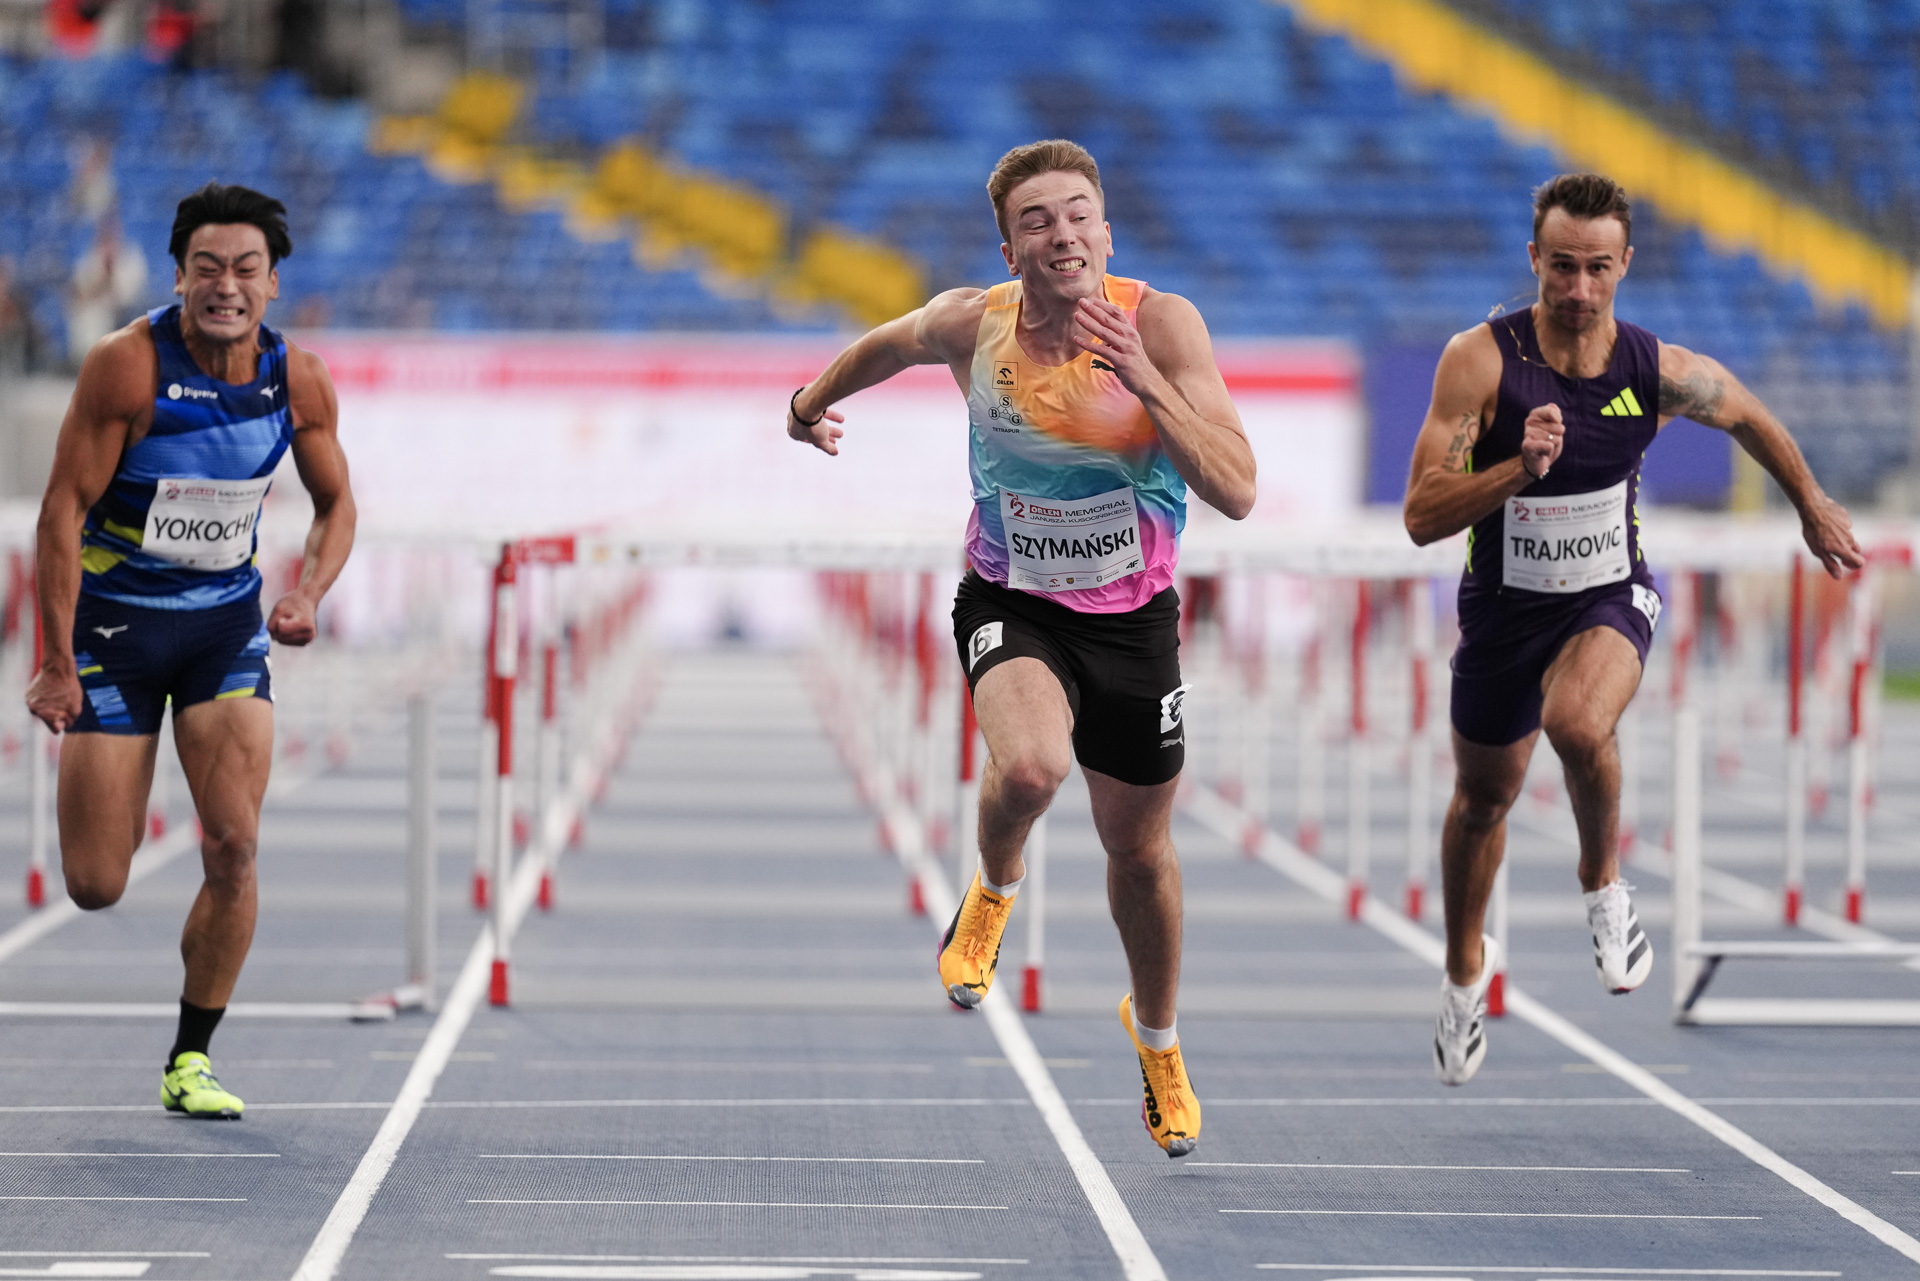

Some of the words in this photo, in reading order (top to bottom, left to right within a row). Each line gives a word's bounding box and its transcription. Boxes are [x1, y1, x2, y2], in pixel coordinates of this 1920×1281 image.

[1002, 397, 1010, 406] S
[991, 409, 998, 418] B
[1011, 414, 1020, 424] G
[1030, 515, 1066, 523] JANUSZA
[1068, 507, 1131, 523] KUSOCIŃSKIEGO
[1031, 506, 1060, 516] ORLEN
[1065, 499, 1129, 517] MEMORIAŁ
[154, 511, 255, 541] YOKOCHI
[1012, 526, 1135, 560] SZYMAŃSKI
[1510, 525, 1620, 561] TRAJKOVIC
[974, 627, 992, 659] 6
